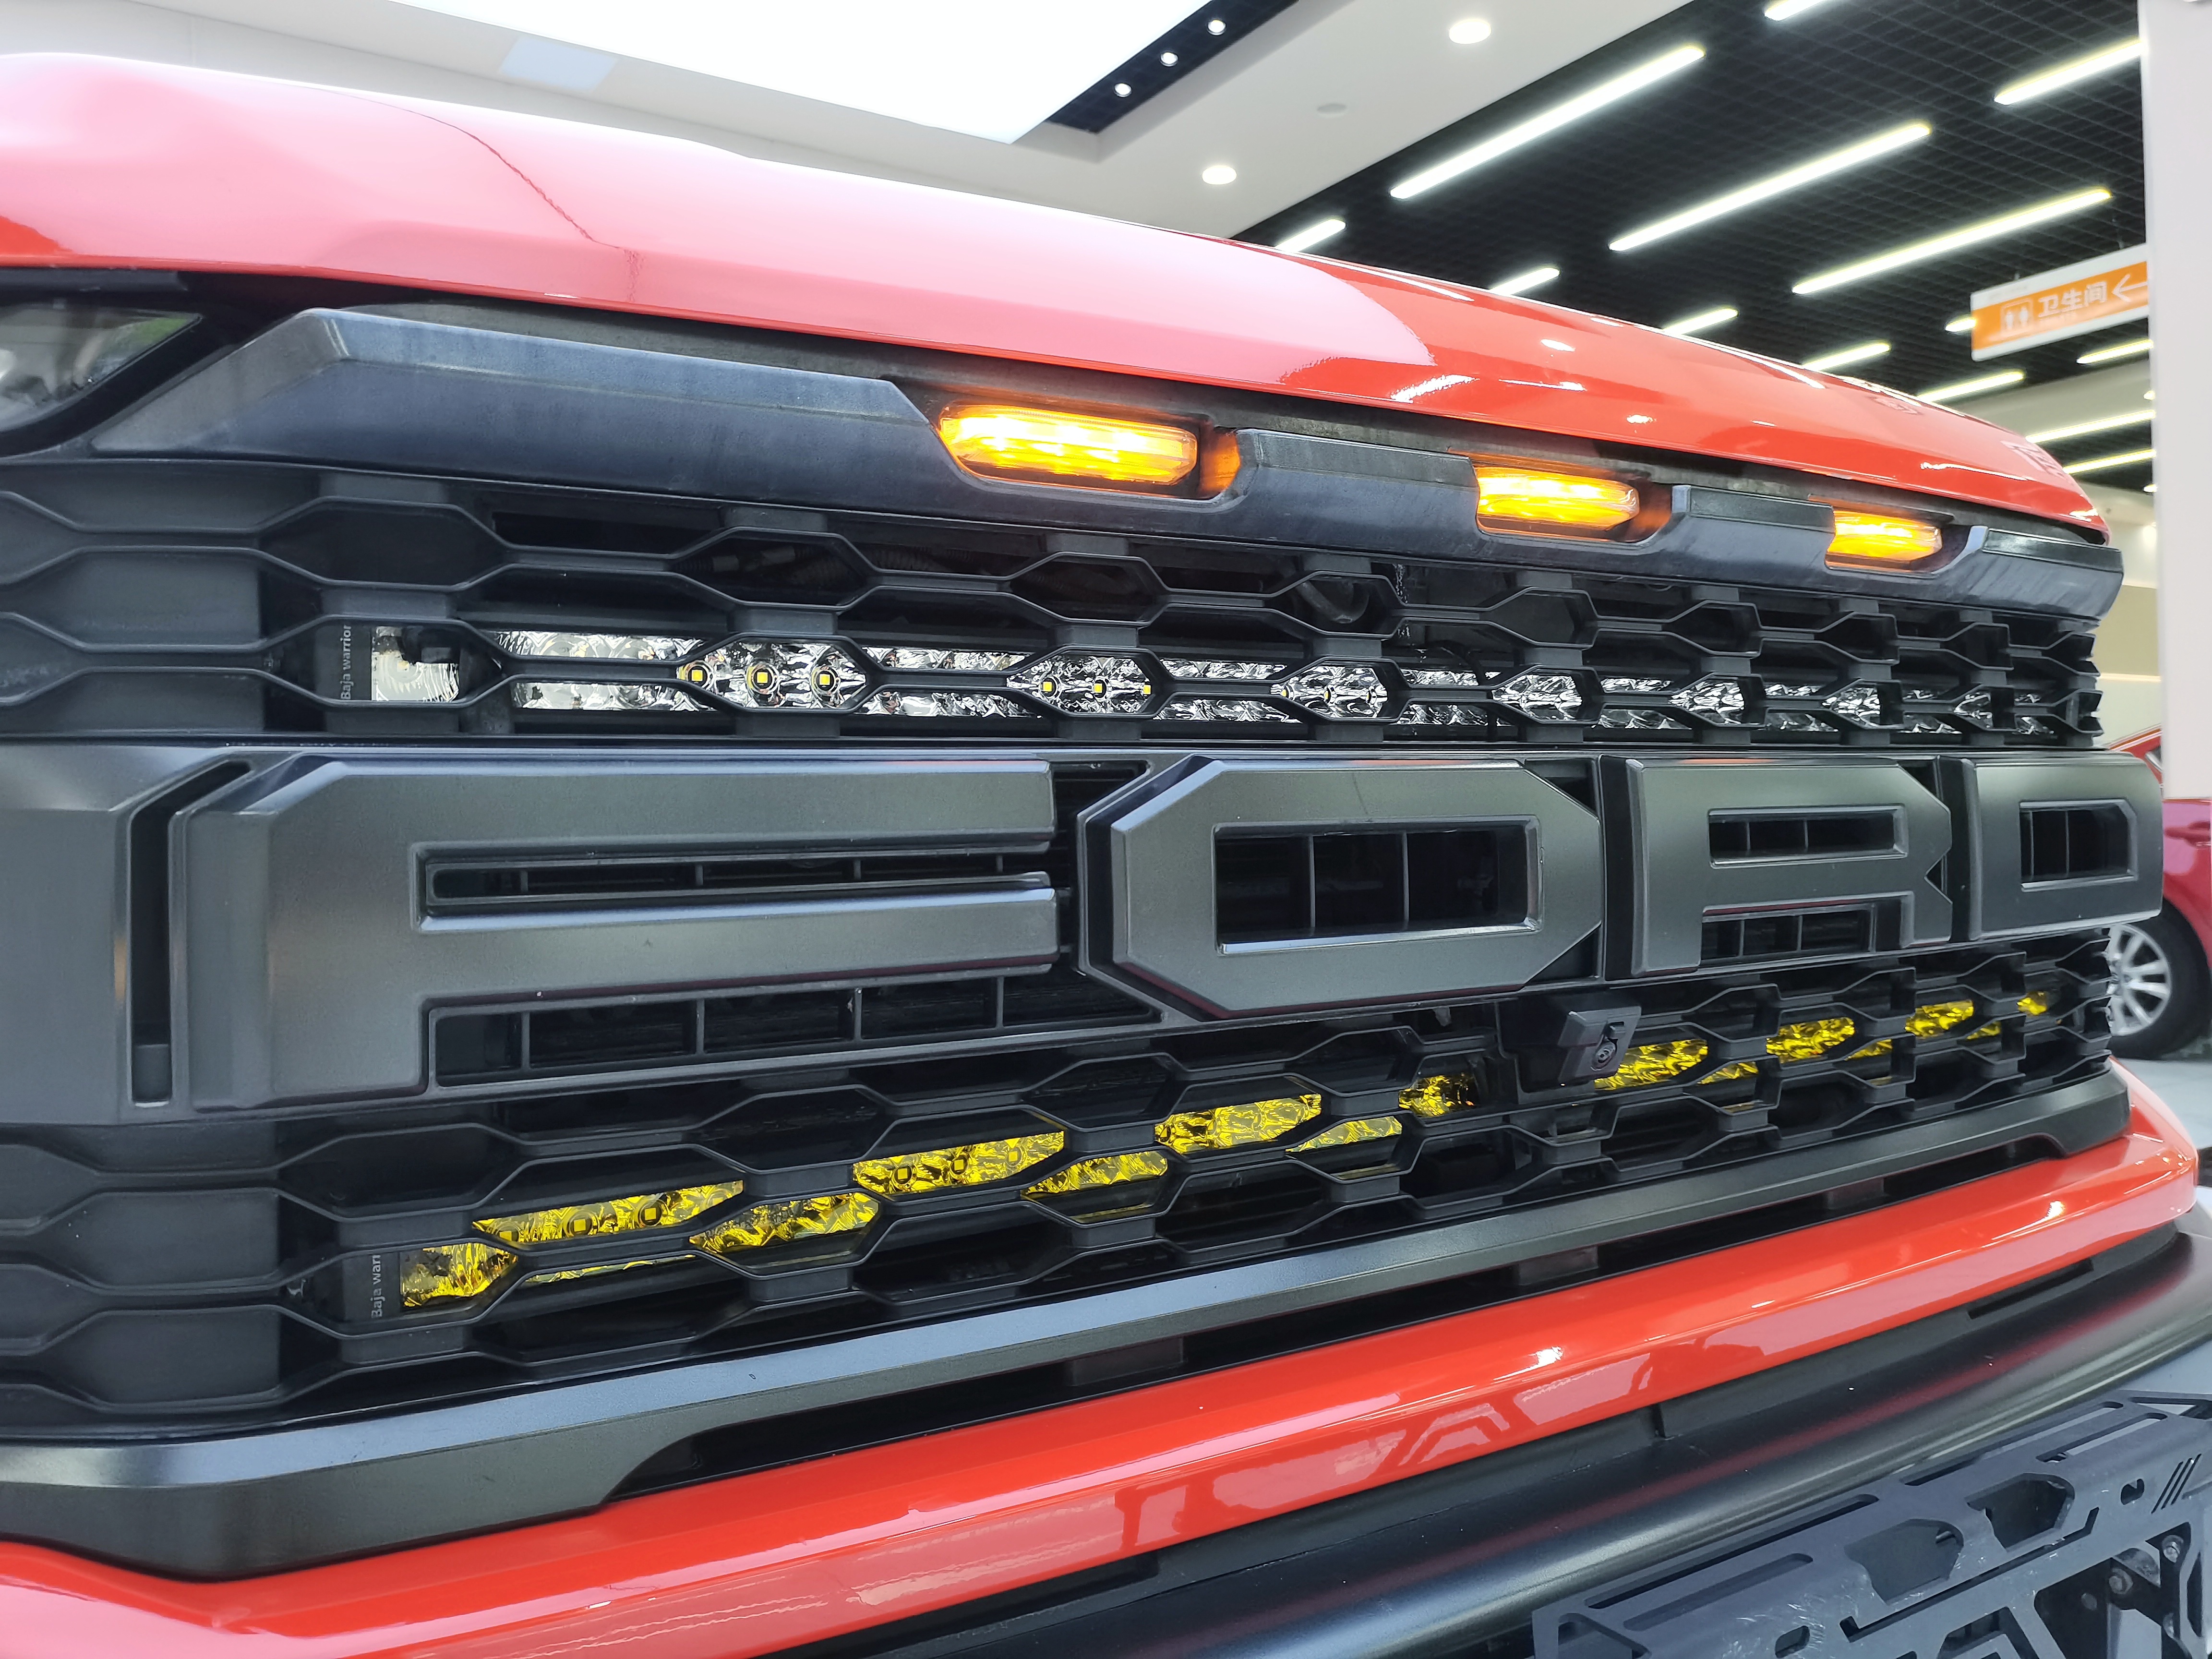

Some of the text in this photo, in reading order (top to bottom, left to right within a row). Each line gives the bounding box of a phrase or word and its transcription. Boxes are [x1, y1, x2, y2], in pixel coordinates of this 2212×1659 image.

[2038, 281, 2107, 317] 卫生间
[339, 625, 354, 700] Baja warrior
[192, 755, 2163, 1109] FORD
[370, 1288, 385, 1318] Baja
